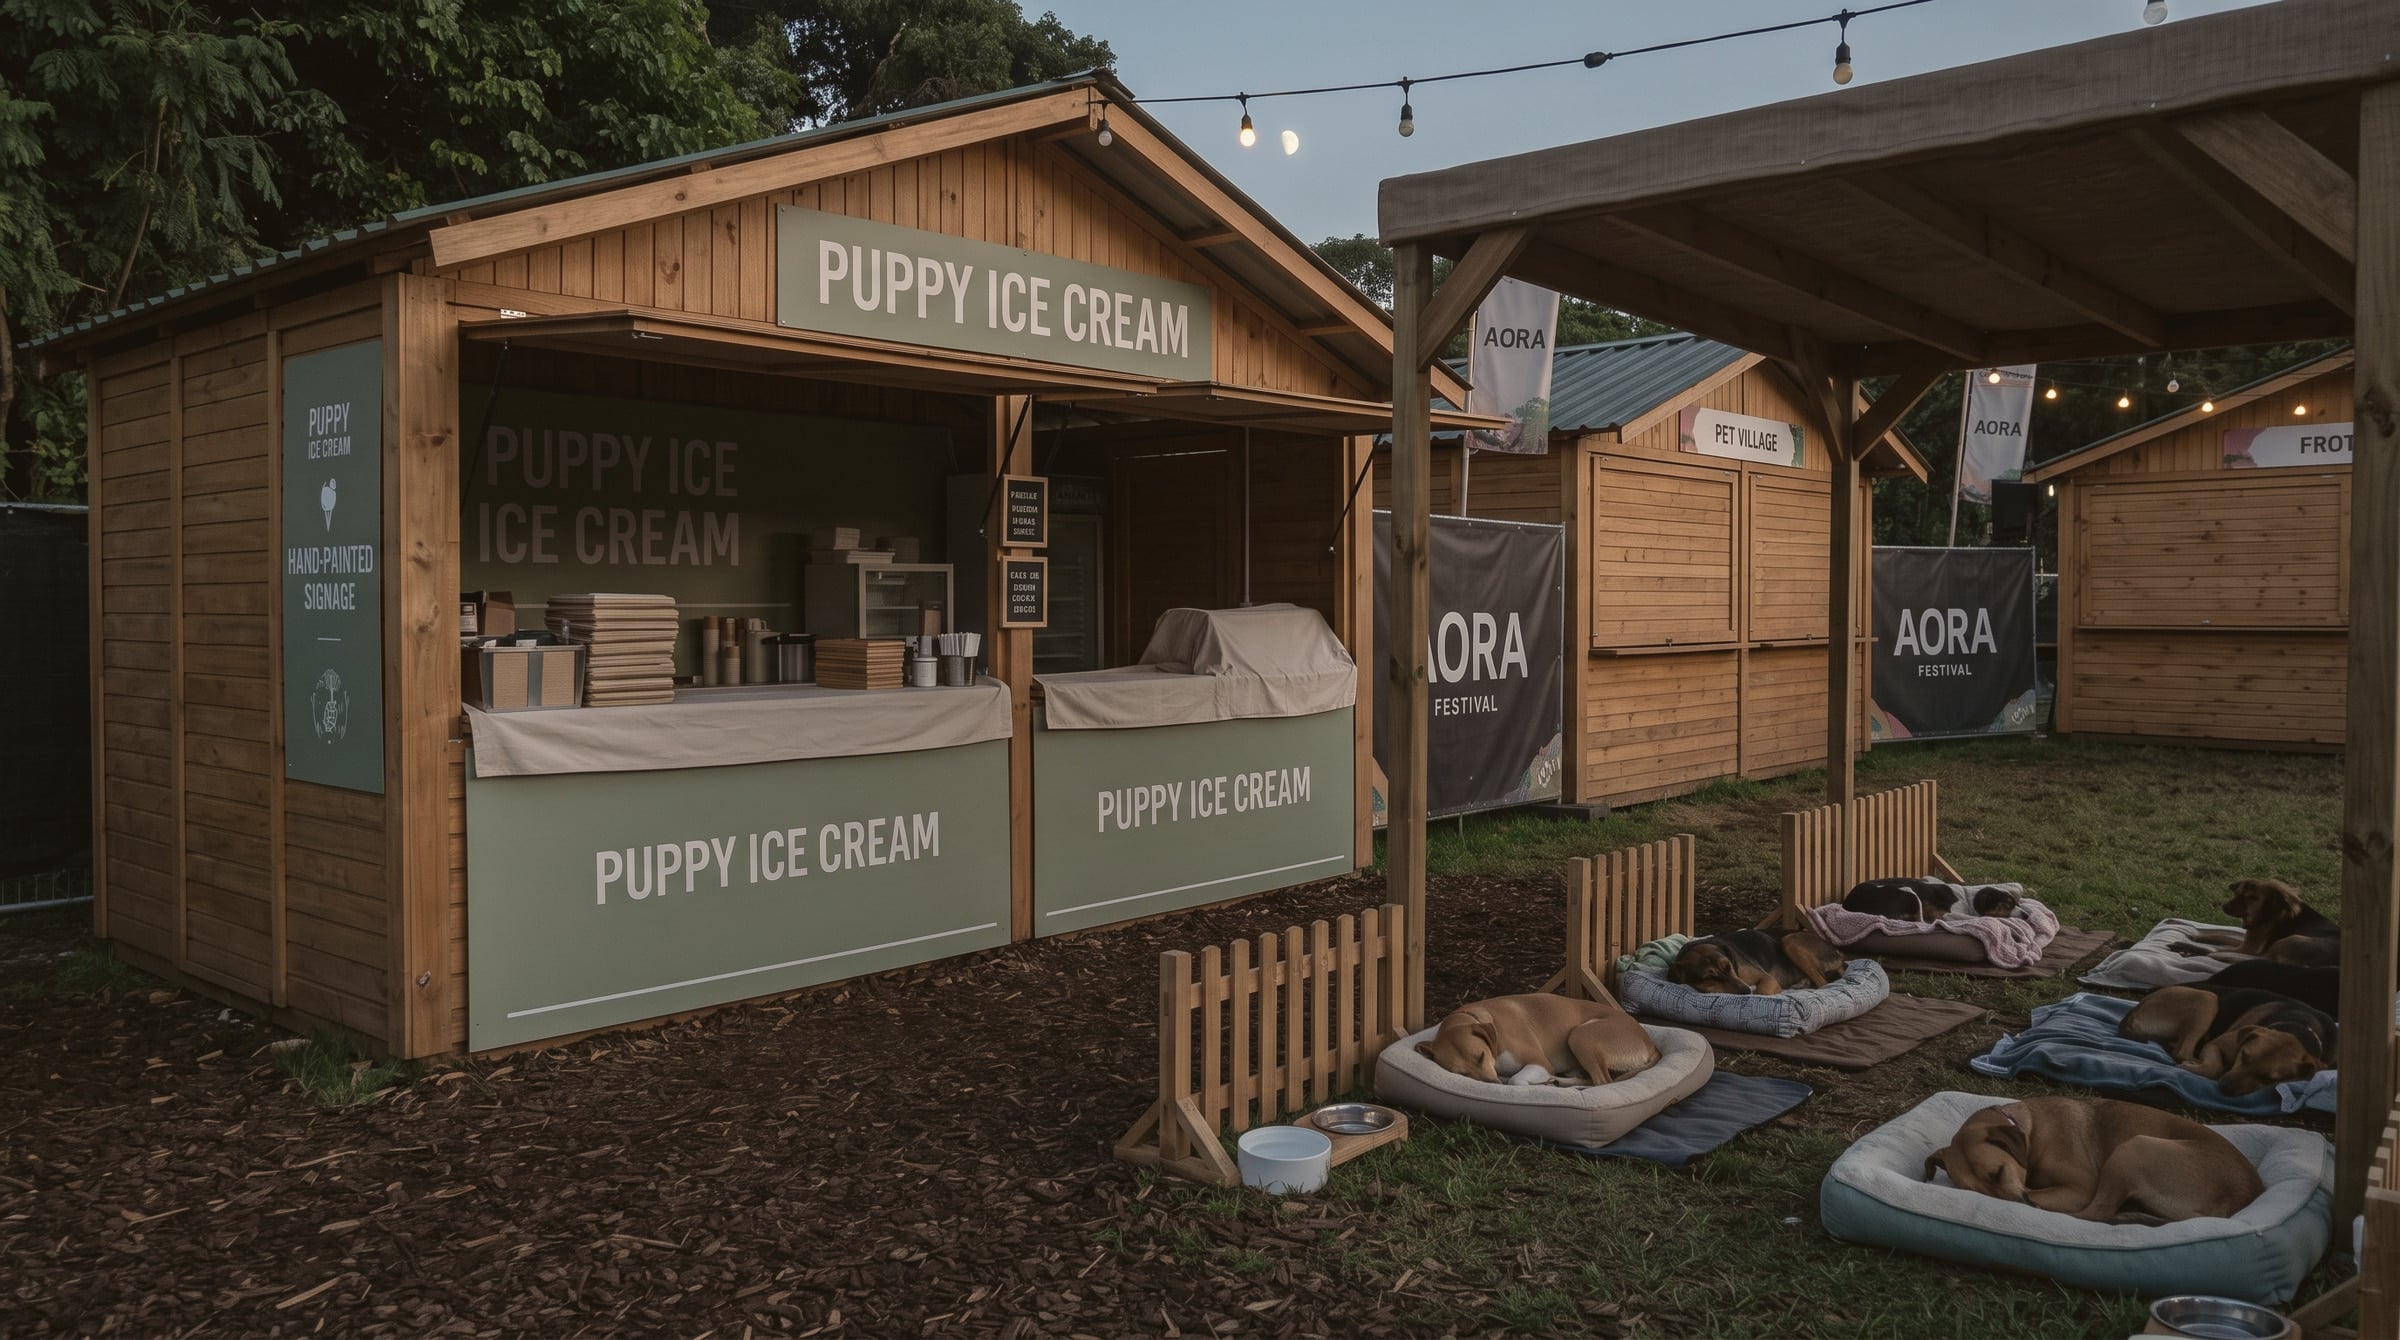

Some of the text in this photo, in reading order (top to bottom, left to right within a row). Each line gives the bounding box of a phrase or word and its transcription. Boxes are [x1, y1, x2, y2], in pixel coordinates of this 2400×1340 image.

[818, 240, 1189, 359] PUPPY ICE CREAM
[1484, 327, 1545, 349] AORA
[309, 402, 350, 437] PUPPY
[1974, 420, 2022, 437] AORA
[308, 436, 351, 460] ICE CREAM
[1715, 423, 1777, 452] PET VILLAGE
[487, 424, 738, 497] PUPPY ICE
[479, 502, 740, 567] ICE CREAM
[288, 544, 374, 575] HAND-PAINTED
[304, 583, 356, 611] SIGNAGE
[1894, 608, 1997, 656] AORA
[1918, 664, 1972, 677] FESTIVAL
[1435, 695, 1498, 716] FESTIVAL
[1099, 766, 1311, 833] PUPPY ICE CREAM
[596, 812, 940, 905] PUPPY ICE CREAM
